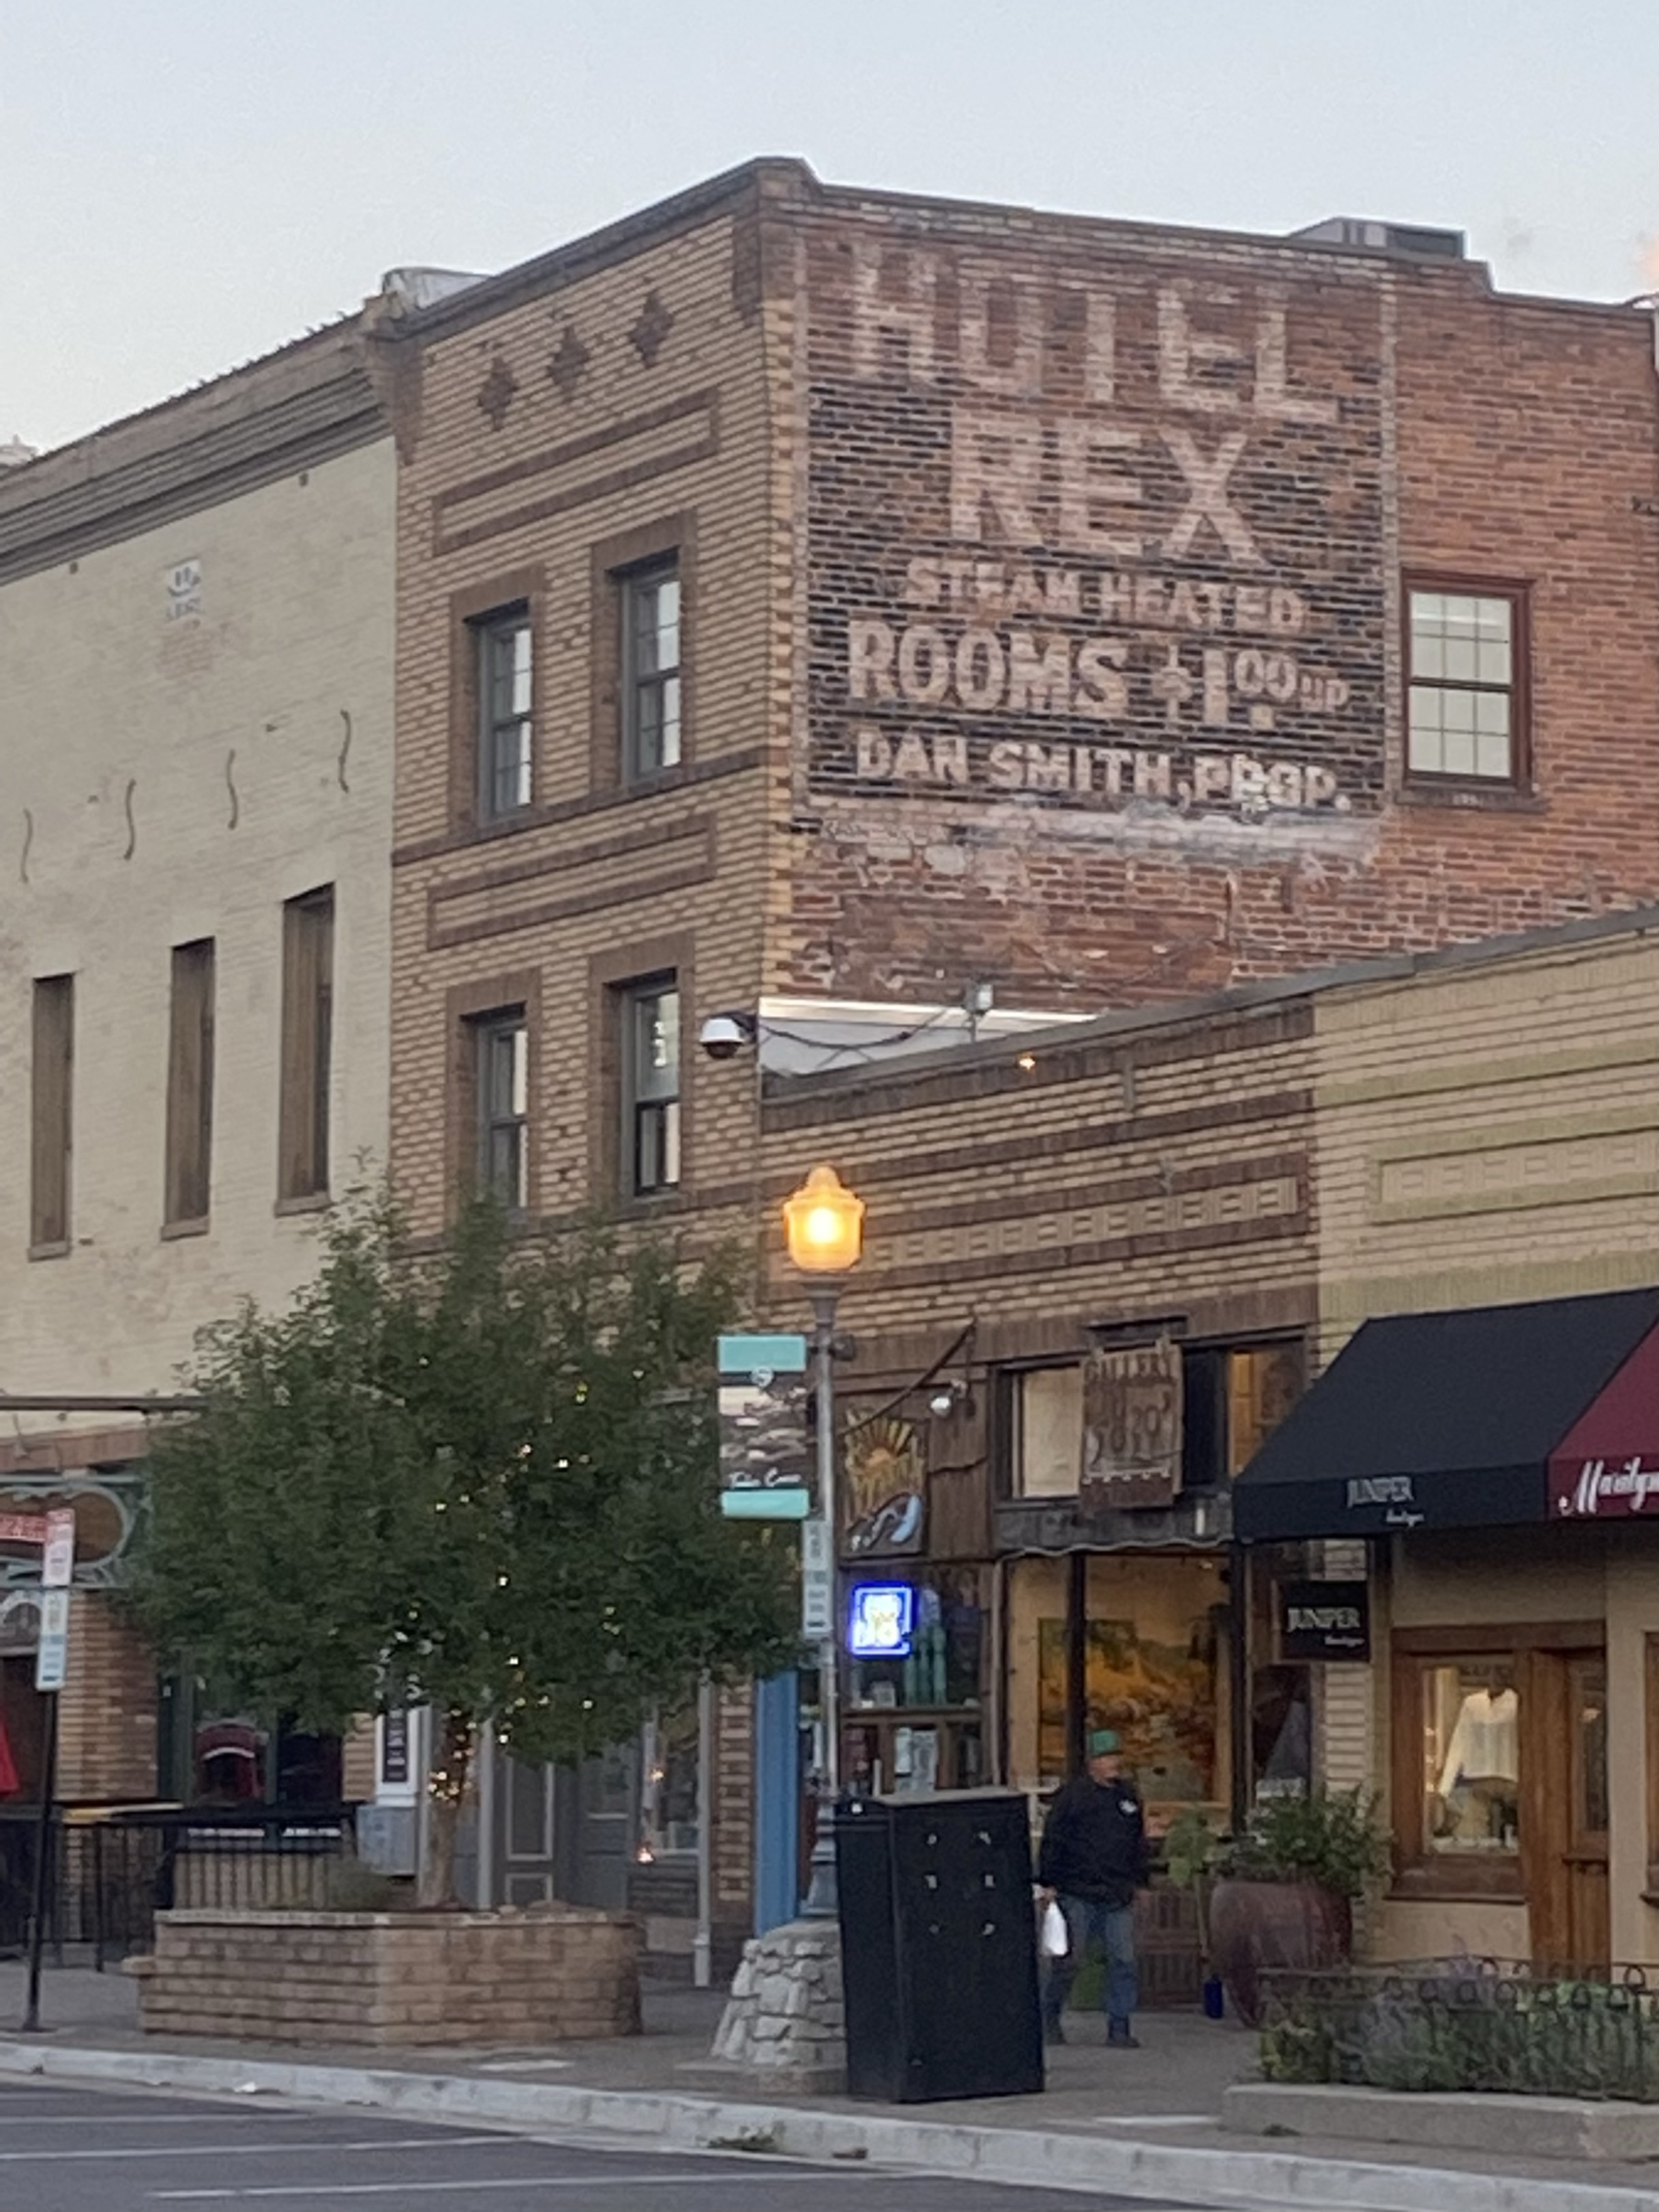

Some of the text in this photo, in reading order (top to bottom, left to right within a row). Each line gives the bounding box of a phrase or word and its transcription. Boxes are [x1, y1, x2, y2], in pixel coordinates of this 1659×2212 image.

[847, 237, 1338, 423] HOTEL
[951, 413, 1266, 569] REX
[904, 555, 1307, 634] STEAM HEATED
[846, 619, 1130, 720] ROOMS
[855, 725, 969, 784] DAN
[1287, 1606, 1360, 1633] JUNIPER
